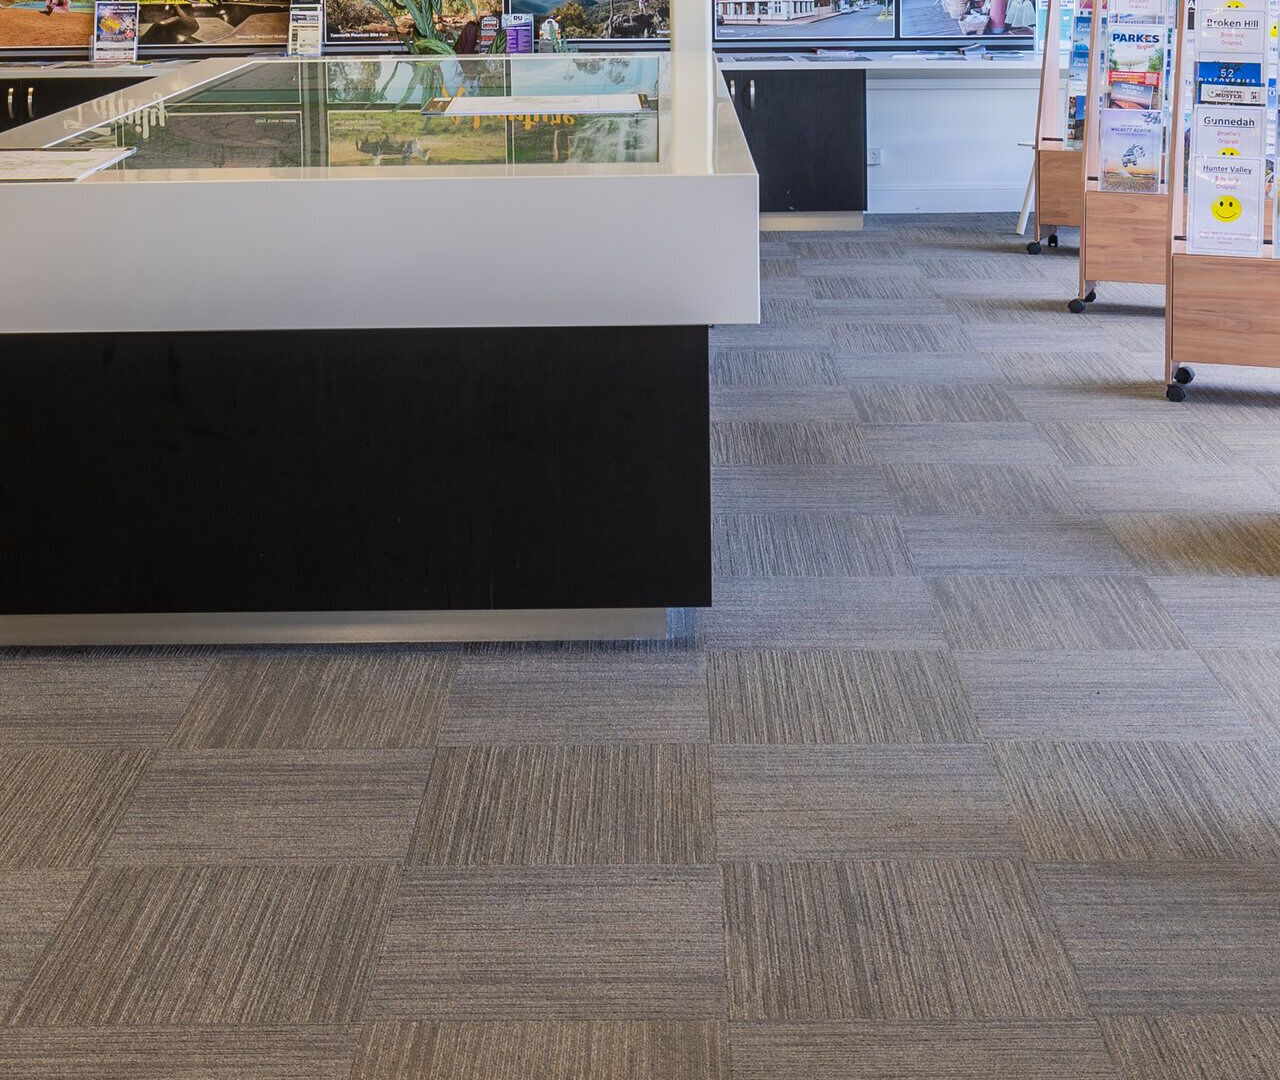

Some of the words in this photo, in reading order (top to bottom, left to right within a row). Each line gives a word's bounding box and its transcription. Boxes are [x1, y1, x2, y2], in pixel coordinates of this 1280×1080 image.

[1206, 18, 1242, 27] Broken
[1244, 19, 1259, 27] Hill
[1112, 33, 1160, 43] PARKES
[1220, 68, 1234, 78] 52
[1203, 116, 1255, 127] Gunnedah
[1230, 165, 1253, 175] Valley
